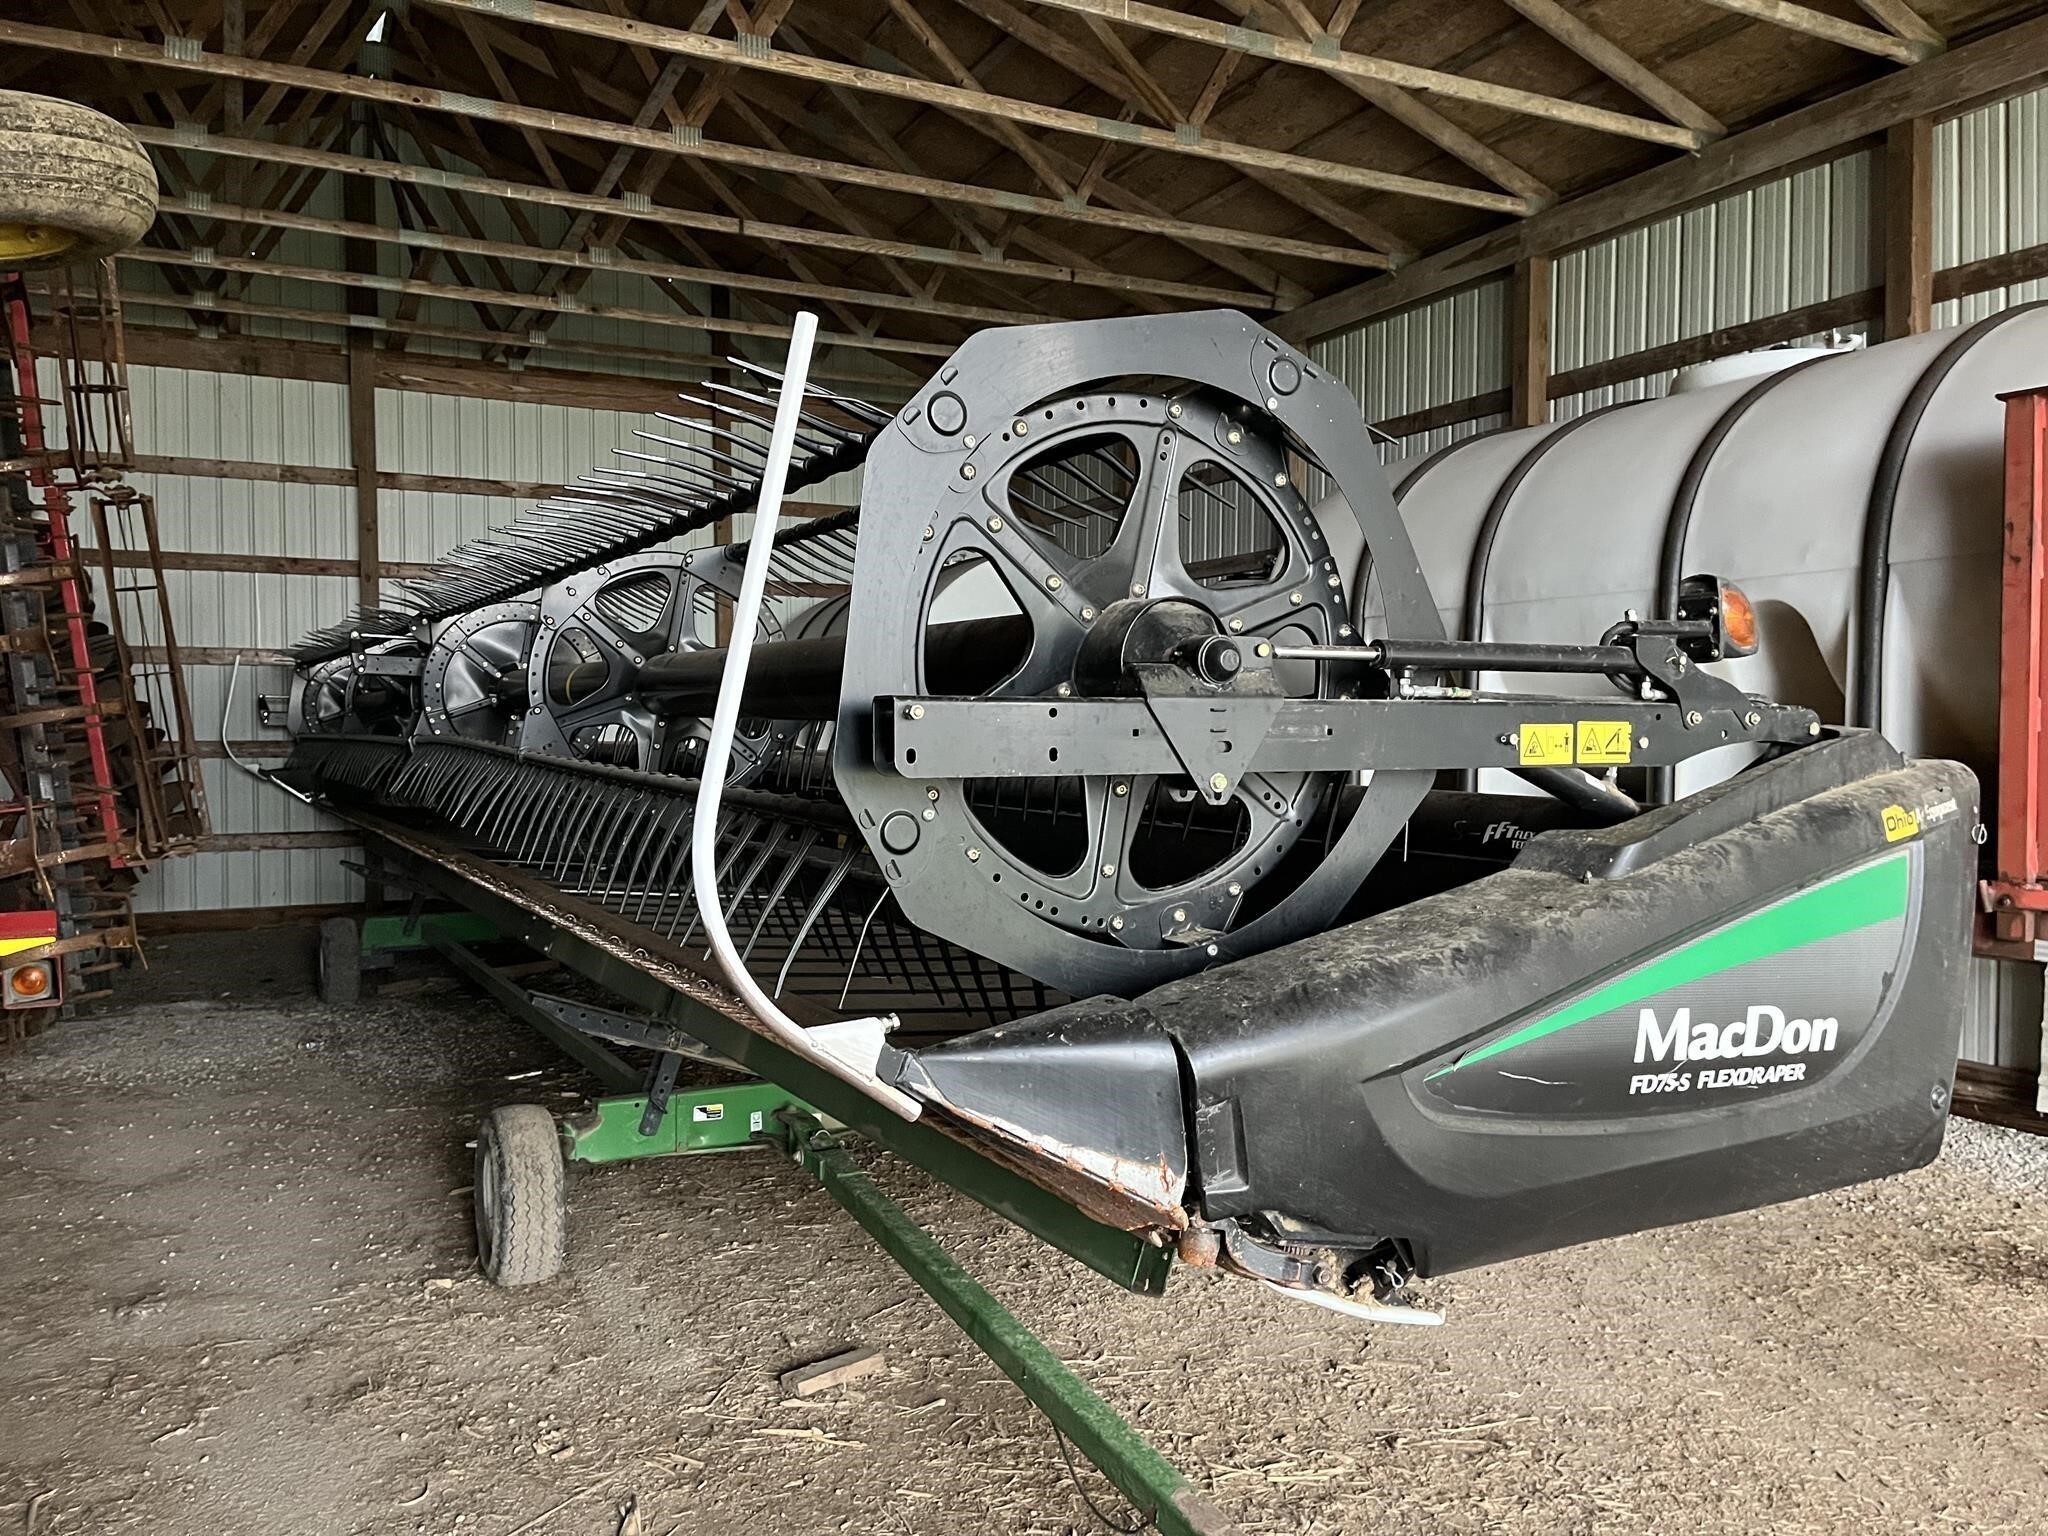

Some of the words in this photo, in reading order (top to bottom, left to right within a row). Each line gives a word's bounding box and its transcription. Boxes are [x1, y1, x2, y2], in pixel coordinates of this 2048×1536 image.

[1886, 814, 1914, 832] Ohio
[1633, 1005, 1839, 1063] MacDon
[1697, 1063, 1807, 1089] FLEXDRAPER
